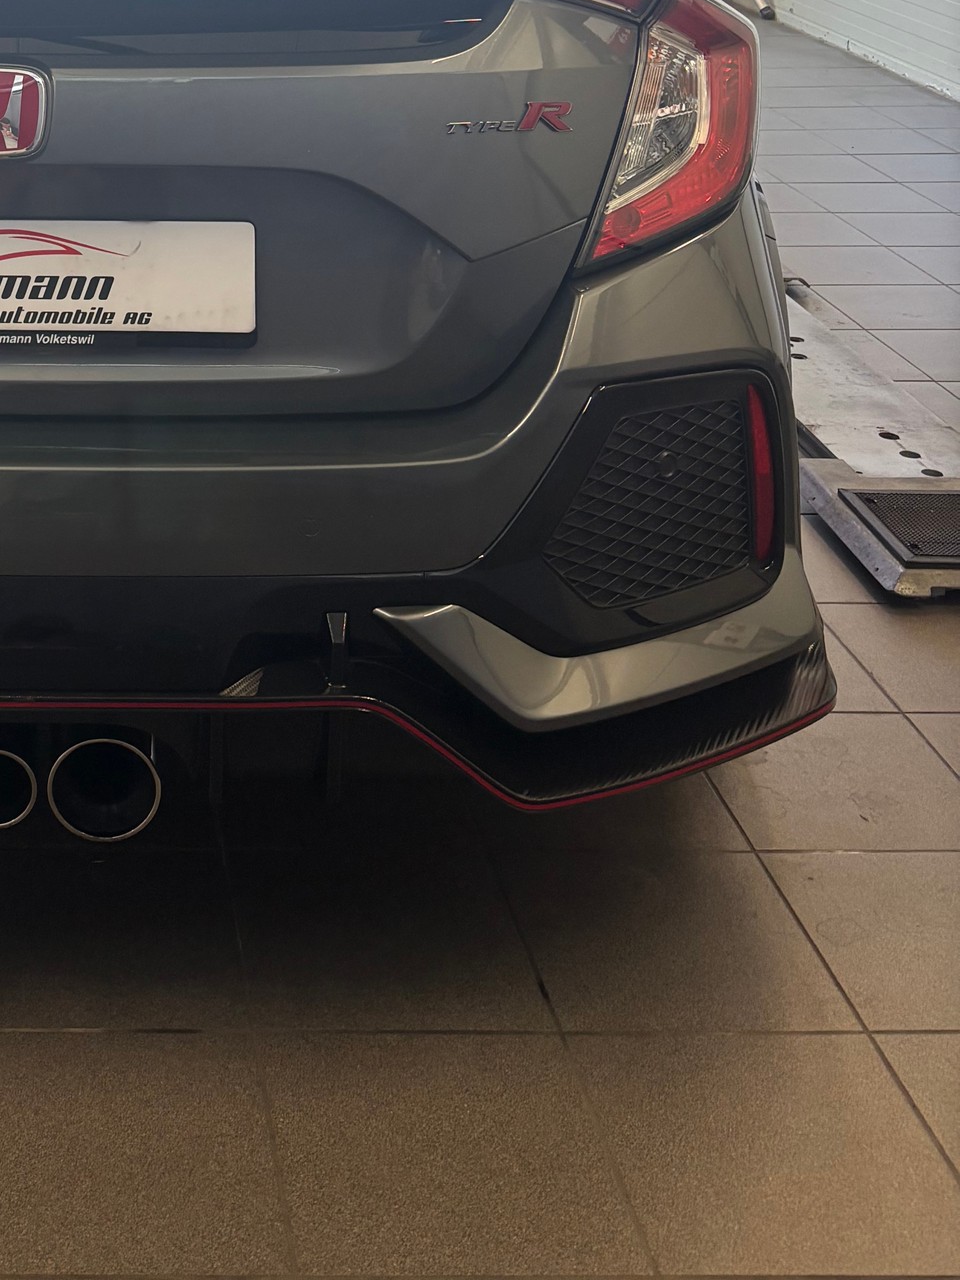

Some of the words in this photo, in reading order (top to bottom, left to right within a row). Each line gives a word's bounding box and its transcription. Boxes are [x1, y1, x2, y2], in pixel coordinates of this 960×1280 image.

[446, 120, 516, 134] TYPE
[517, 101, 574, 132] R
[122, 311, 153, 325] AG
[36, 333, 95, 346] Volketswil
